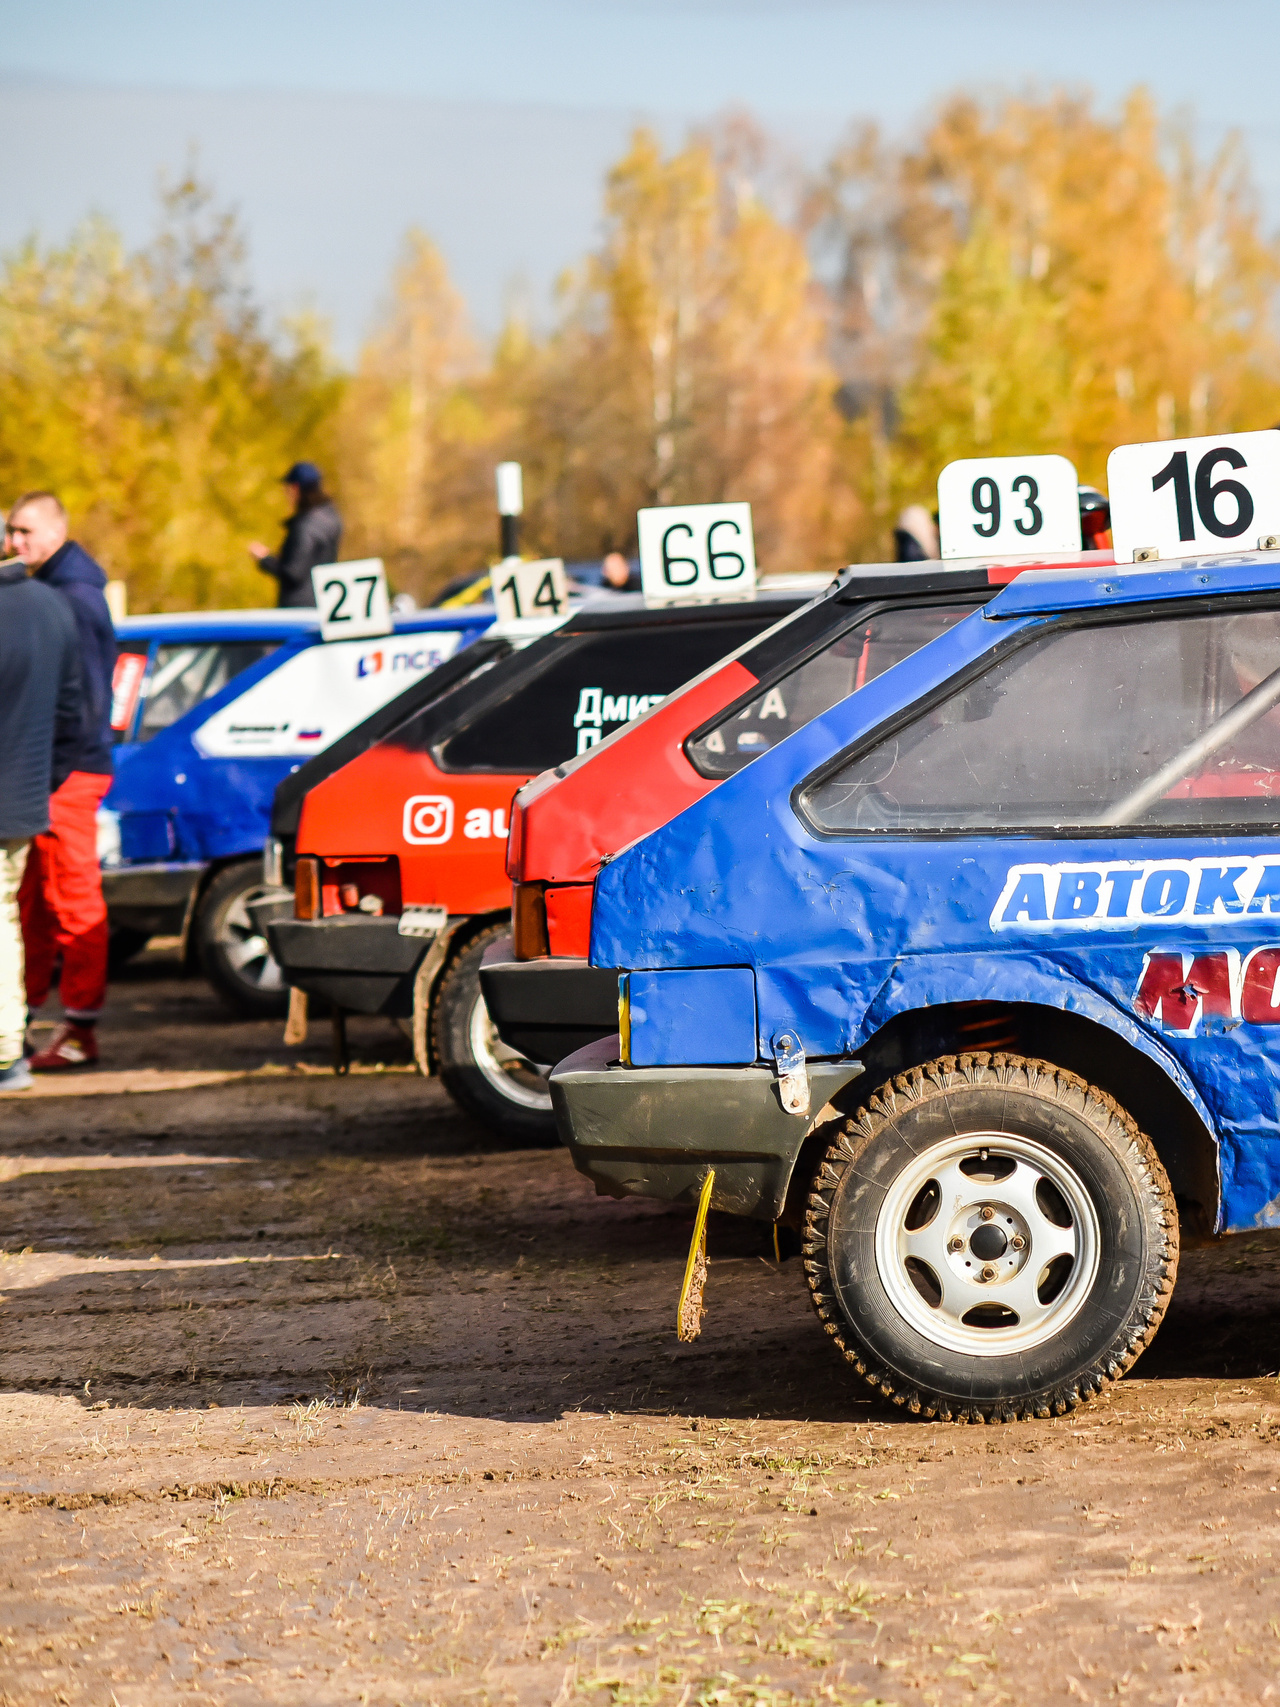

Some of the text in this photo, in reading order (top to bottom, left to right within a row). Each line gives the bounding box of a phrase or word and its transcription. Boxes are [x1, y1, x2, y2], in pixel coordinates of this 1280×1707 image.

[970, 475, 1043, 538] 93
[1151, 446, 1254, 541] 16
[661, 520, 745, 586] 66
[323, 575, 379, 622] 27
[500, 571, 562, 618] 14
